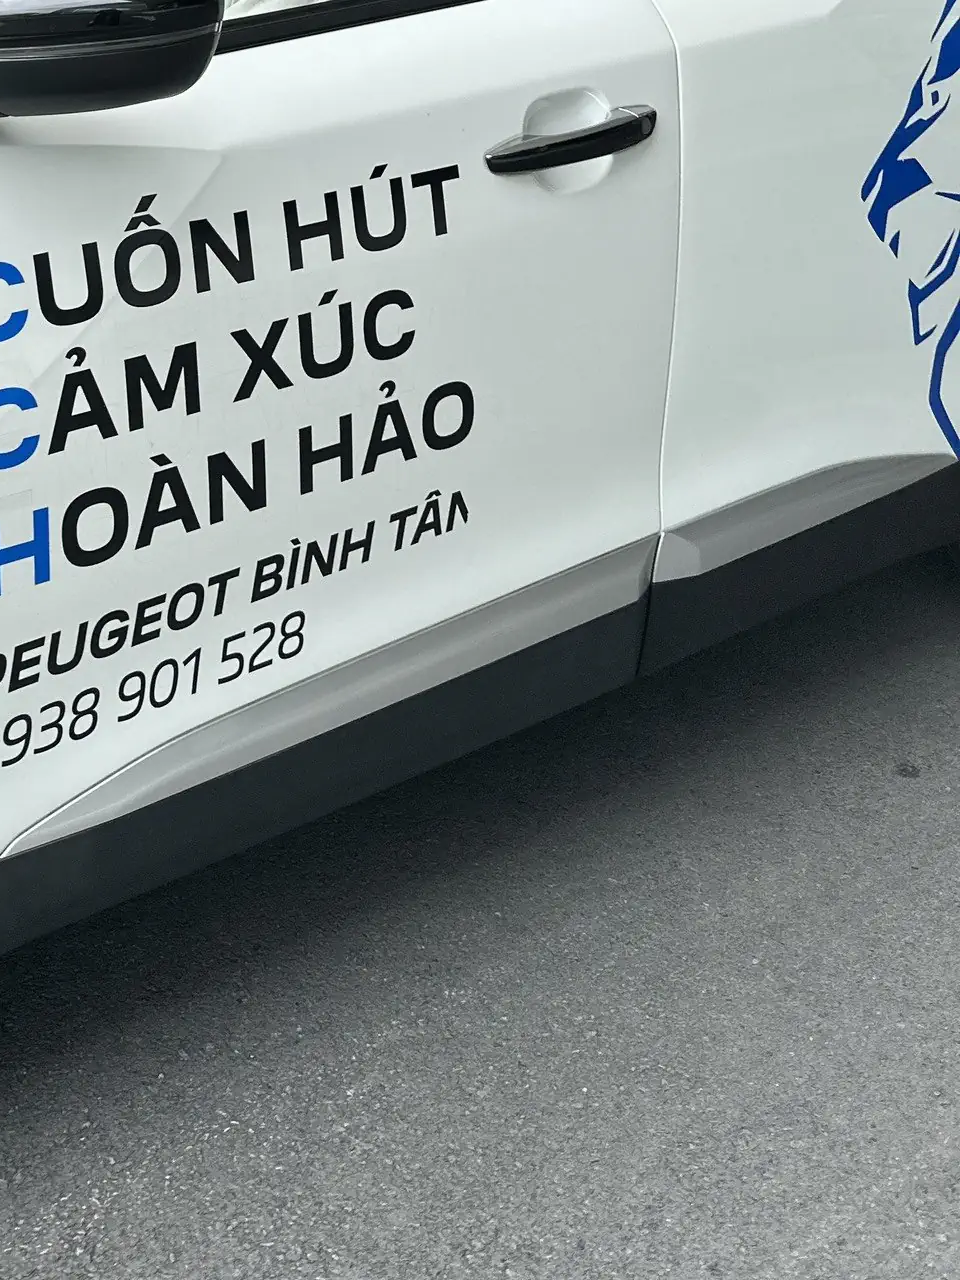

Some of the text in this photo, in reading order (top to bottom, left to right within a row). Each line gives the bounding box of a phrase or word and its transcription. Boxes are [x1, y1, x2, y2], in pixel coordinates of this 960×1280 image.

[282, 163, 460, 272] HÚT
[229, 289, 416, 403] XÚC
[298, 379, 475, 496] HẢO
[250, 502, 376, 604] BÌNH
[117, 647, 202, 723] 901
[217, 610, 306, 685] 528
